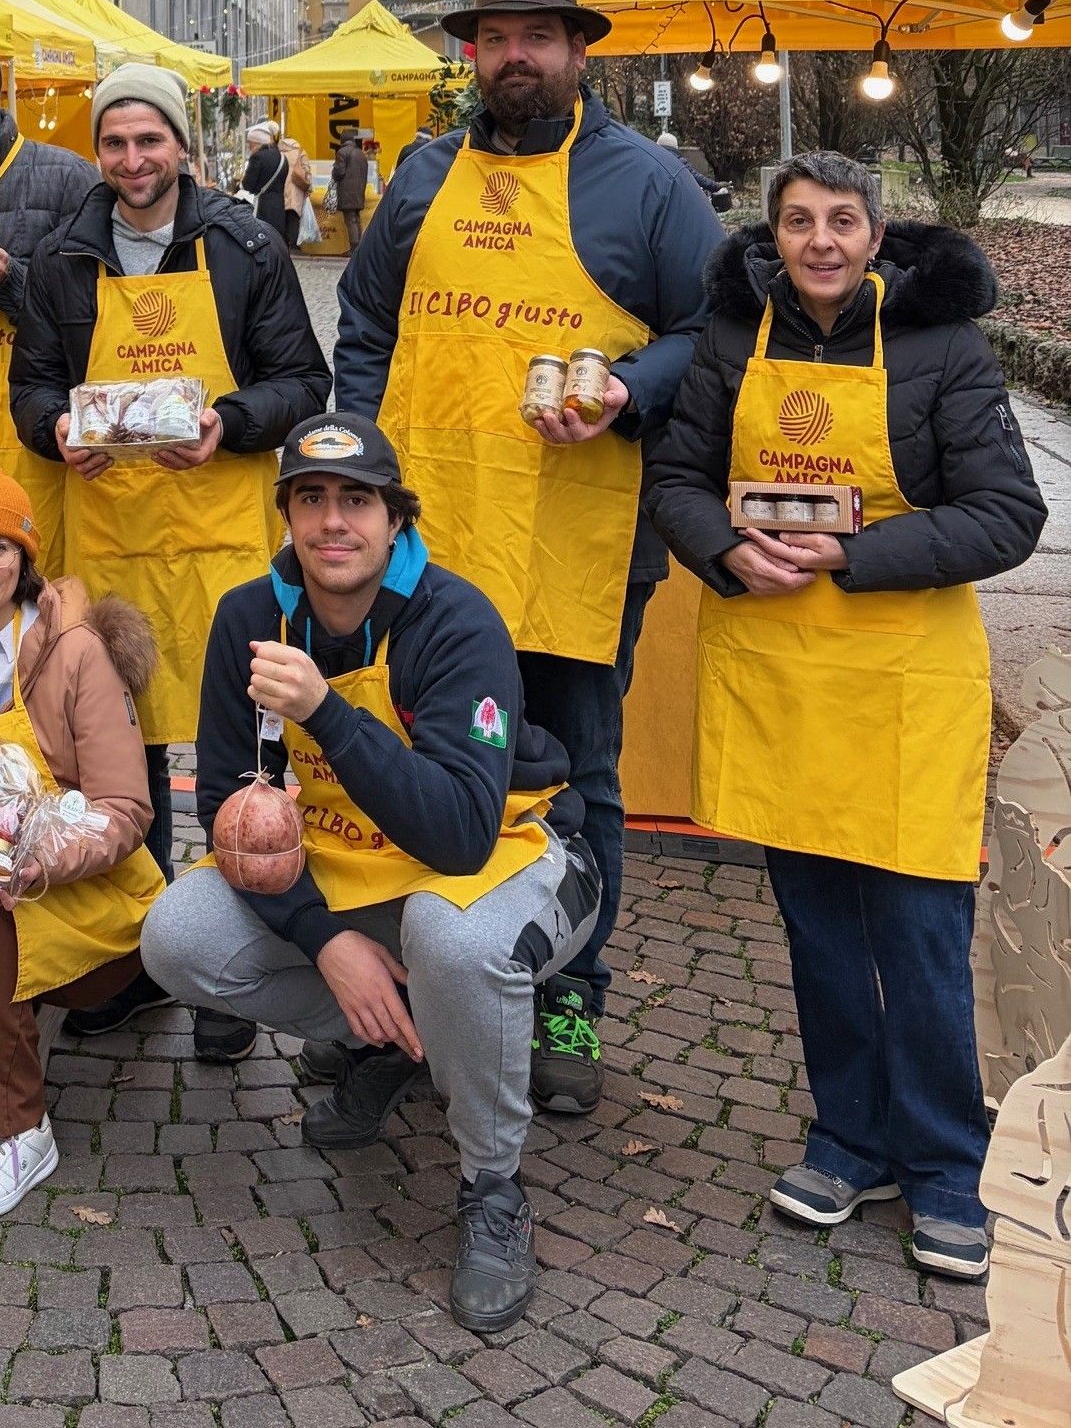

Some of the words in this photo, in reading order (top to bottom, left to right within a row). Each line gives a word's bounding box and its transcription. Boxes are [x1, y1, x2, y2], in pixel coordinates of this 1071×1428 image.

[391, 73, 437, 82] CAMPAGNA
[453, 219, 533, 237] CAMPAGNA
[462, 234, 515, 251] AMICA
[426, 291, 491, 318] CIBO
[495, 299, 583, 329] giusto
[116, 341, 197, 359] CAMPAGNA
[131, 358, 183, 373] AMICA
[759, 449, 855, 474] CAMPAGNA
[303, 805, 363, 842] CIBO
